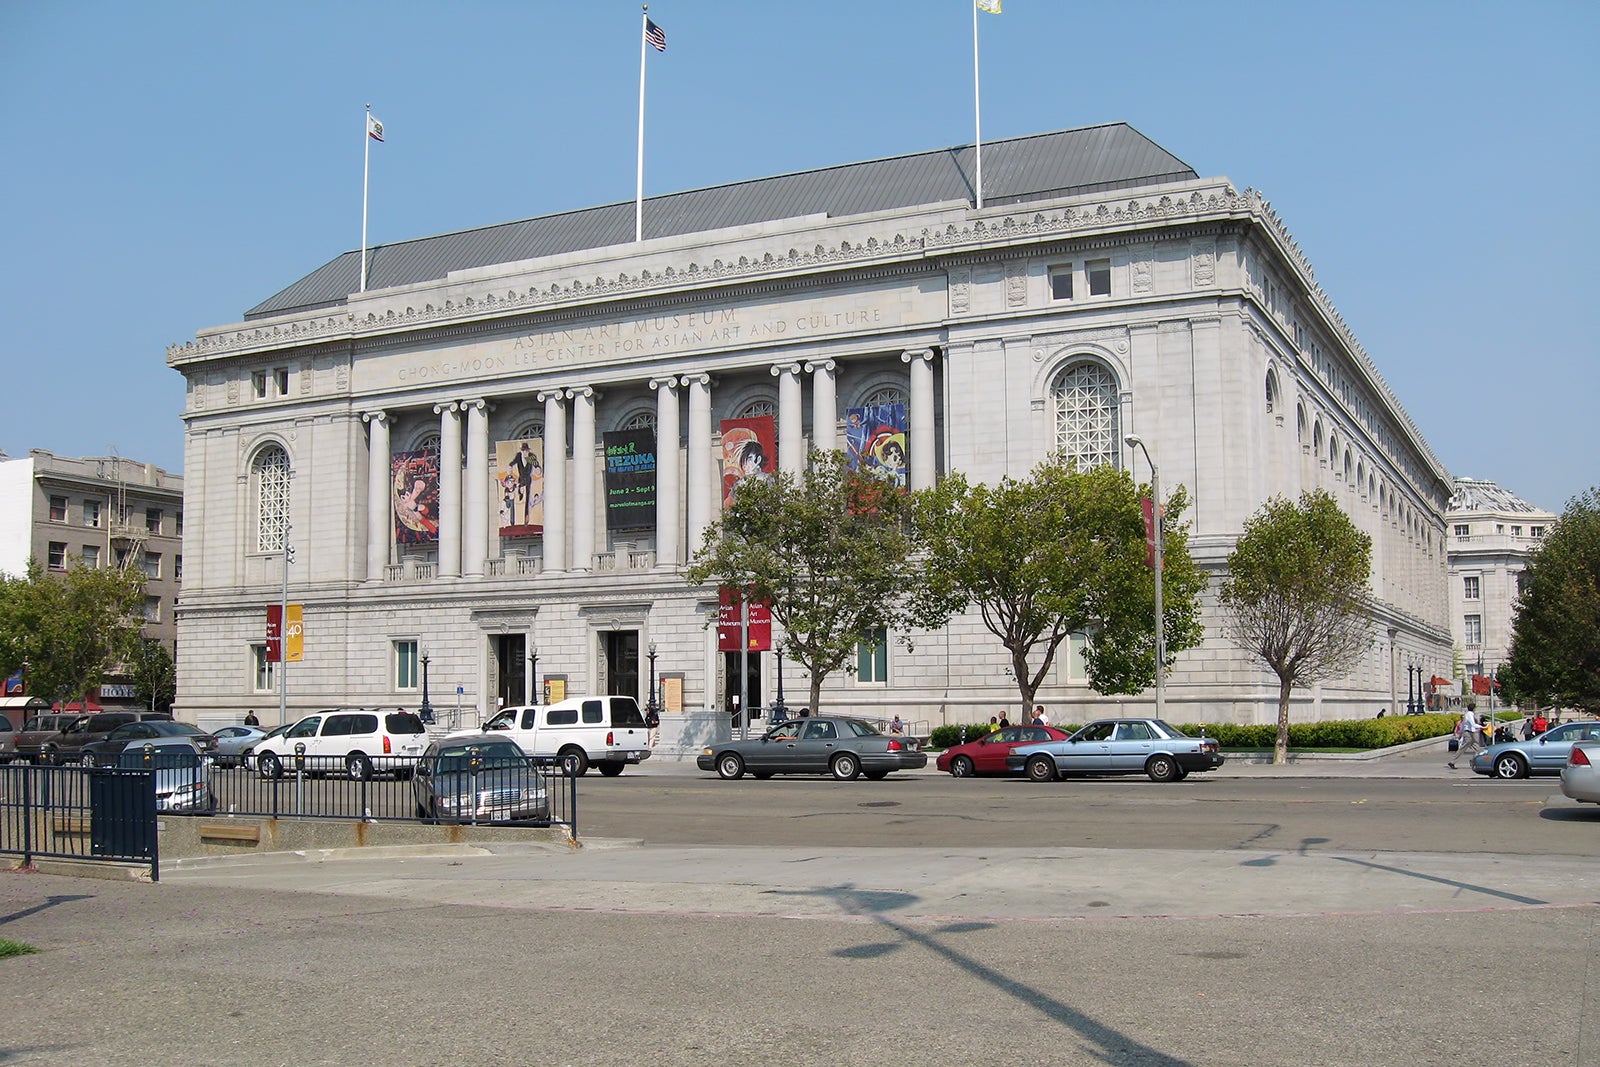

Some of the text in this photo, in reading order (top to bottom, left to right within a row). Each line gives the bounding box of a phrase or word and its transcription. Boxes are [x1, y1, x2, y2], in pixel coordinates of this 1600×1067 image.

[514, 308, 736, 350] ASIAN ART MUSEUM
[398, 309, 881, 381] CHONG-MOON LEE CENTER FOR ASIAN ART AND CULTURE
[608, 453, 655, 467] TEZUKA
[288, 625, 302, 638] 40
[103, 689, 134, 697] HOTE
